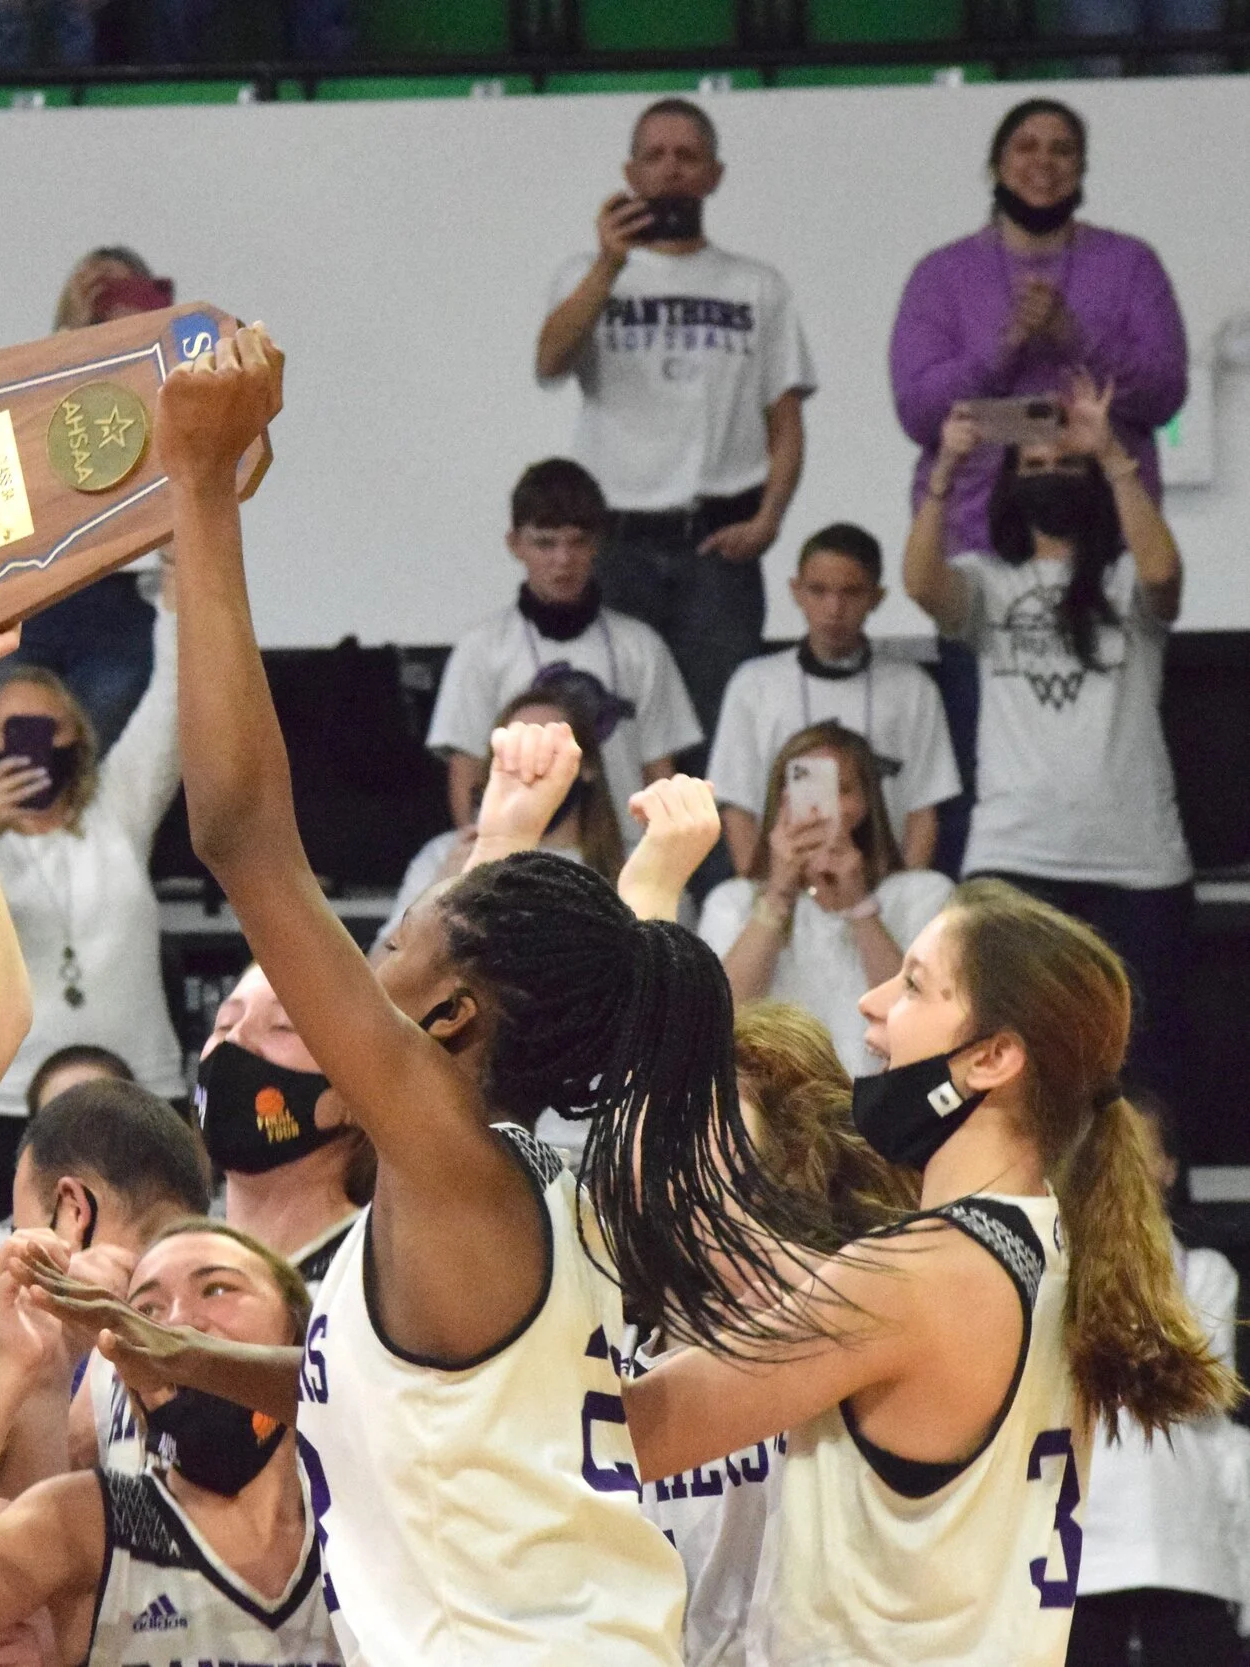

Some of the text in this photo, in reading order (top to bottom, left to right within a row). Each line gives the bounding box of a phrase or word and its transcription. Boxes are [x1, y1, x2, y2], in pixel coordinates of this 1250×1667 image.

[605, 295, 754, 332] PANTHERS
[607, 324, 754, 356] SOFTBALL
[61, 400, 94, 485] AHSAA
[132, 1614, 189, 1633] adidas
